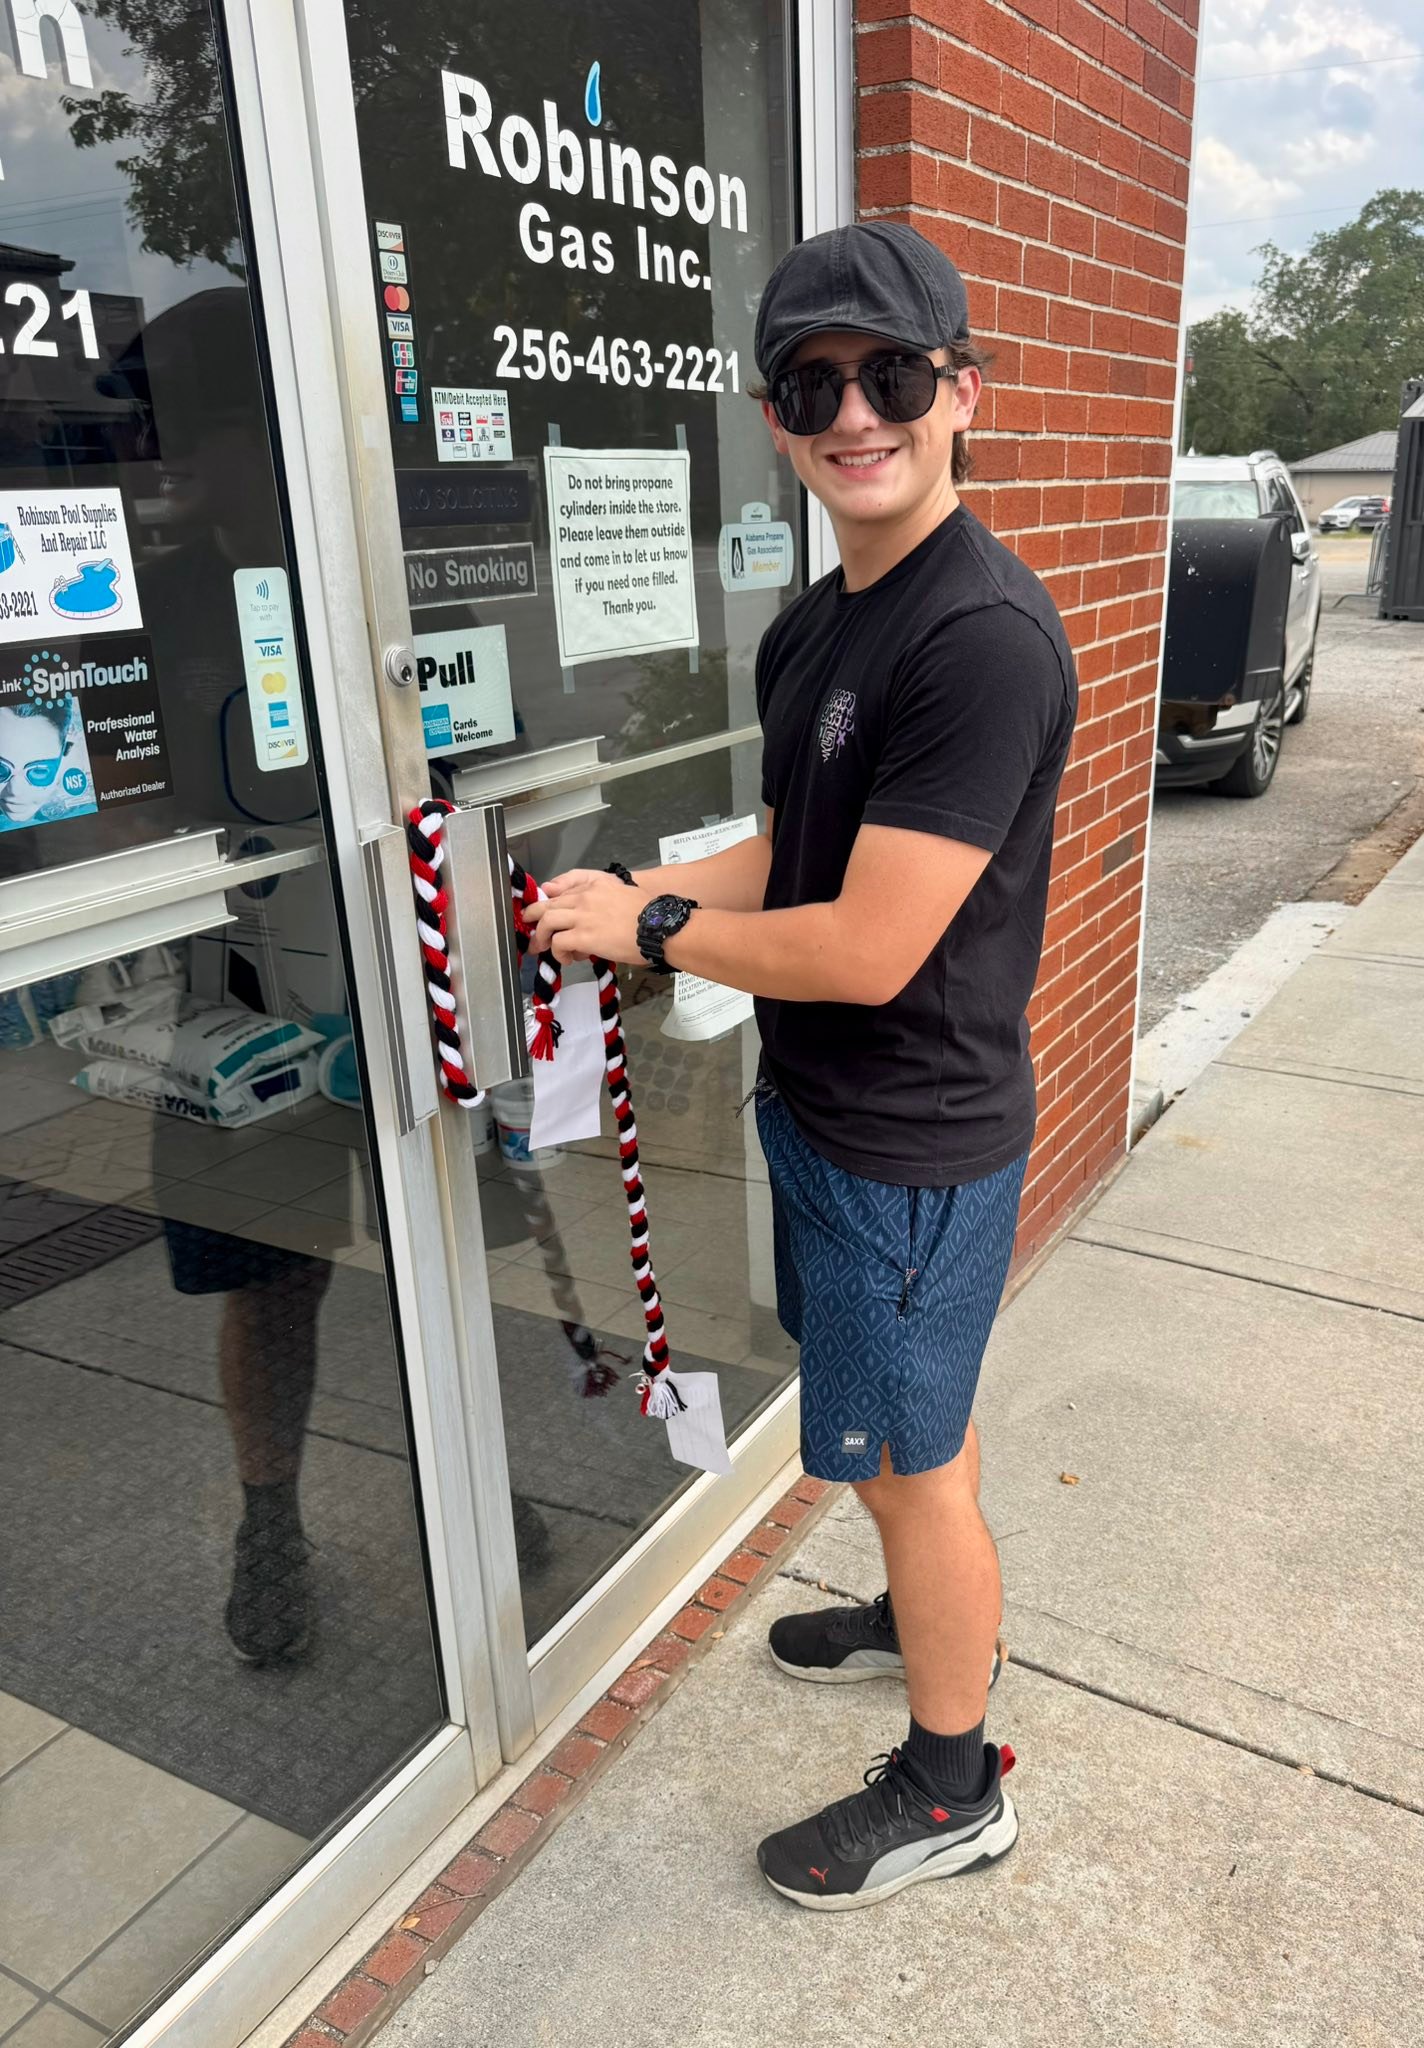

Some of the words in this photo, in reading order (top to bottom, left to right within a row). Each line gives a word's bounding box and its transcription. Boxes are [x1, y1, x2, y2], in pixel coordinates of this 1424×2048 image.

[441, 61, 748, 233] Robinson
[519, 202, 615, 275] Gas
[637, 226, 712, 291] Inc.
[0, 283, 100, 359] 21
[391, 321, 410, 332] VISA
[493, 325, 740, 393] 256-463-2221
[434, 391, 465, 405] ATM/Debit
[465, 393, 492, 408] Accepted
[493, 394, 506, 406] Here
[568, 474, 582, 489] Do
[585, 476, 603, 490] not
[605, 475, 630, 492] bring
[632, 478, 673, 492] propane
[17, 505, 60, 526] Robinson
[60, 504, 81, 525] Pool
[81, 503, 118, 529] Supplies
[560, 500, 607, 519] cylinders
[609, 500, 636, 515] inside
[638, 500, 654, 514] the
[656, 500, 682, 514] store.
[560, 527, 594, 542] Please
[596, 525, 624, 541] leave
[625, 524, 649, 540] them
[651, 522, 686, 538] outside
[40, 532, 59, 553] And
[58, 531, 88, 557] Repair
[88, 530, 107, 550] LLC
[747, 547, 756, 555] Gas
[560, 552, 582, 568] and
[584, 554, 610, 567] come
[612, 550, 621, 565] in
[623, 550, 633, 564] to
[635, 548, 648, 563] let
[650, 551, 661, 562] us
[663, 546, 688, 561] know
[408, 562, 438, 590] No
[445, 555, 529, 587] Smoking
[752, 560, 780, 574] Member
[575, 577, 583, 593] if
[585, 580, 605, 596] you
[607, 574, 630, 590] need
[632, 576, 650, 588] one
[652, 570, 678, 587] filled.
[250, 603, 260, 612] Tap
[269, 604, 280, 613] pay
[603, 598, 634, 616] Thank
[636, 600, 656, 615] you.
[259, 645, 283, 657] VISA
[32, 656, 148, 699] SpinTouch
[416, 651, 476, 692] Pull
[87, 711, 156, 733] Professional
[453, 719, 478, 731] Cards
[124, 729, 158, 744] Water
[454, 729, 494, 743] Welcome
[116, 744, 160, 762] Analysis
[65, 774, 84, 789] NSF
[100, 785, 142, 801] Authorized
[142, 781, 166, 793] Dealer
[844, 1437, 865, 1446] SAXX
